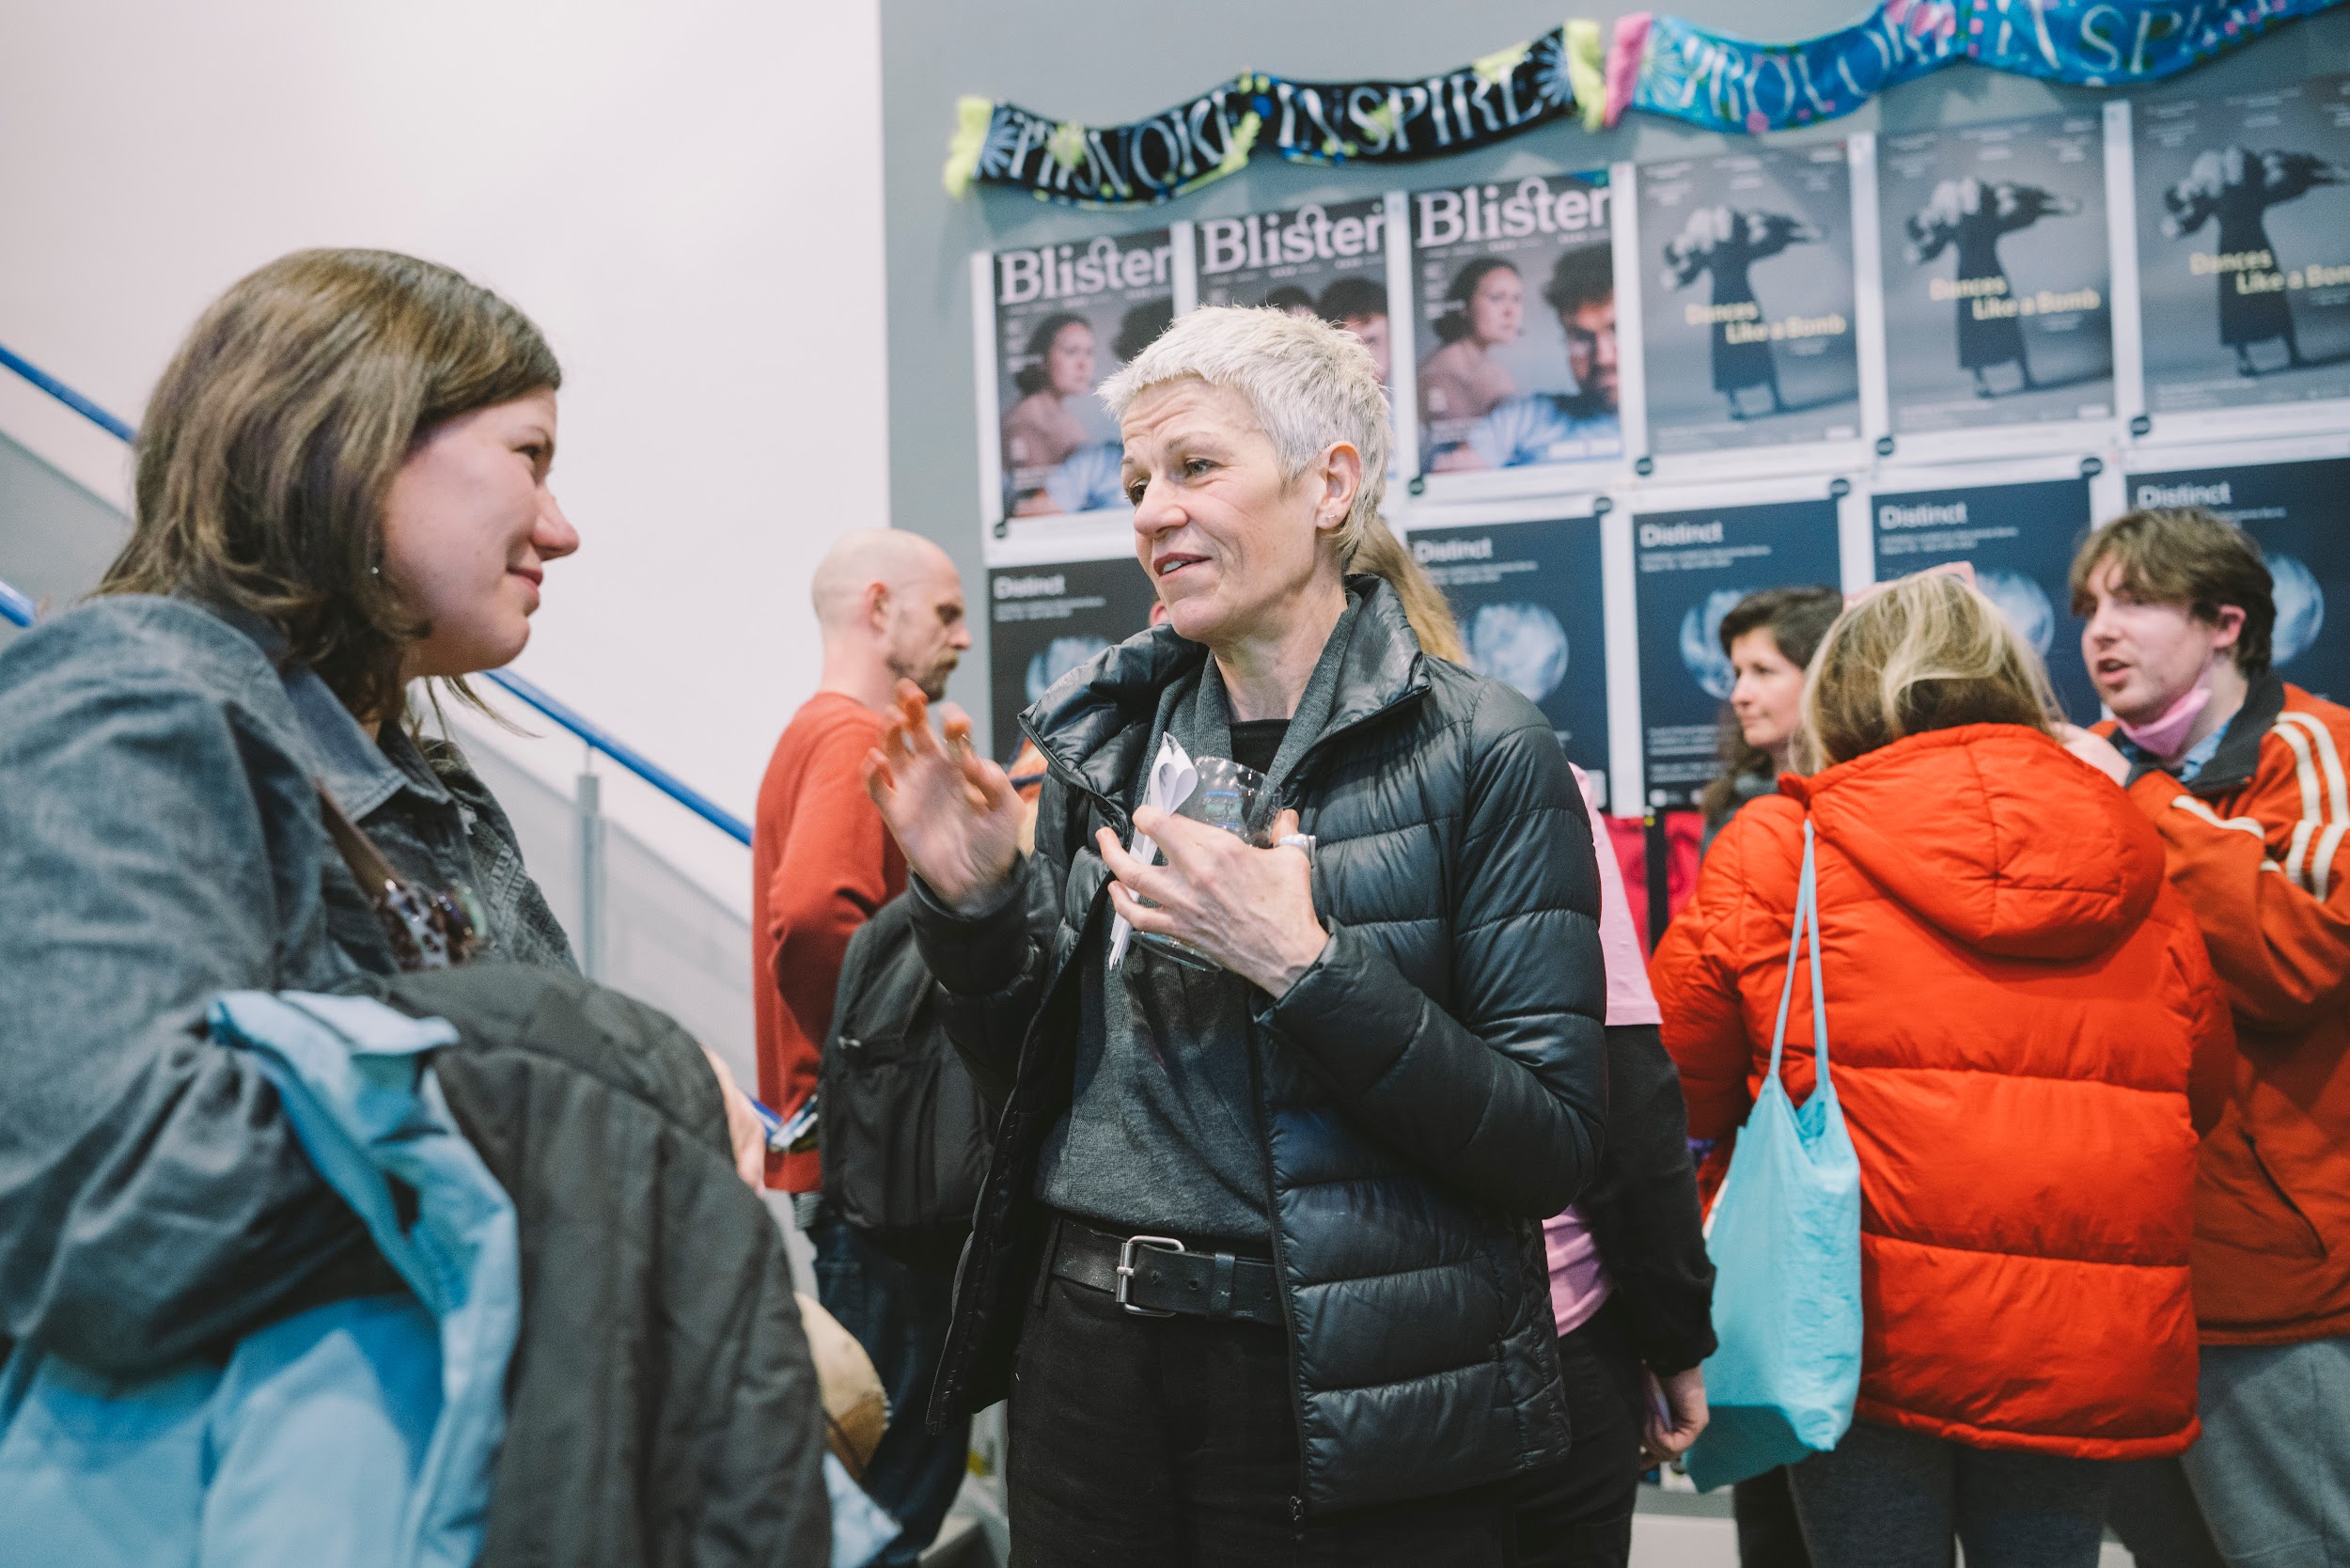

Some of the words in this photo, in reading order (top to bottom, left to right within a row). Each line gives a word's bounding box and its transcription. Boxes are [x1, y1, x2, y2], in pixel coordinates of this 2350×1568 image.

[1277, 55, 1544, 155] INSPIRE
[1417, 175, 1611, 249] Blister
[1201, 202, 1386, 275] Blister
[999, 235, 1173, 306] Blister
[2236, 270, 2285, 295] Like
[2287, 270, 2303, 290] a
[1973, 296, 2018, 321] Like
[2019, 296, 2036, 316] a
[2037, 287, 2101, 314] Bomb
[1726, 321, 1768, 345] Like
[1770, 321, 1785, 340] a
[1786, 313, 1846, 338] Bomb
[2137, 480, 2232, 510] Distinct
[1879, 501, 1967, 530] Distinct
[1639, 520, 1724, 547] Distinct
[1414, 536, 1493, 564] Distinct
[993, 573, 1066, 599] Distinct
